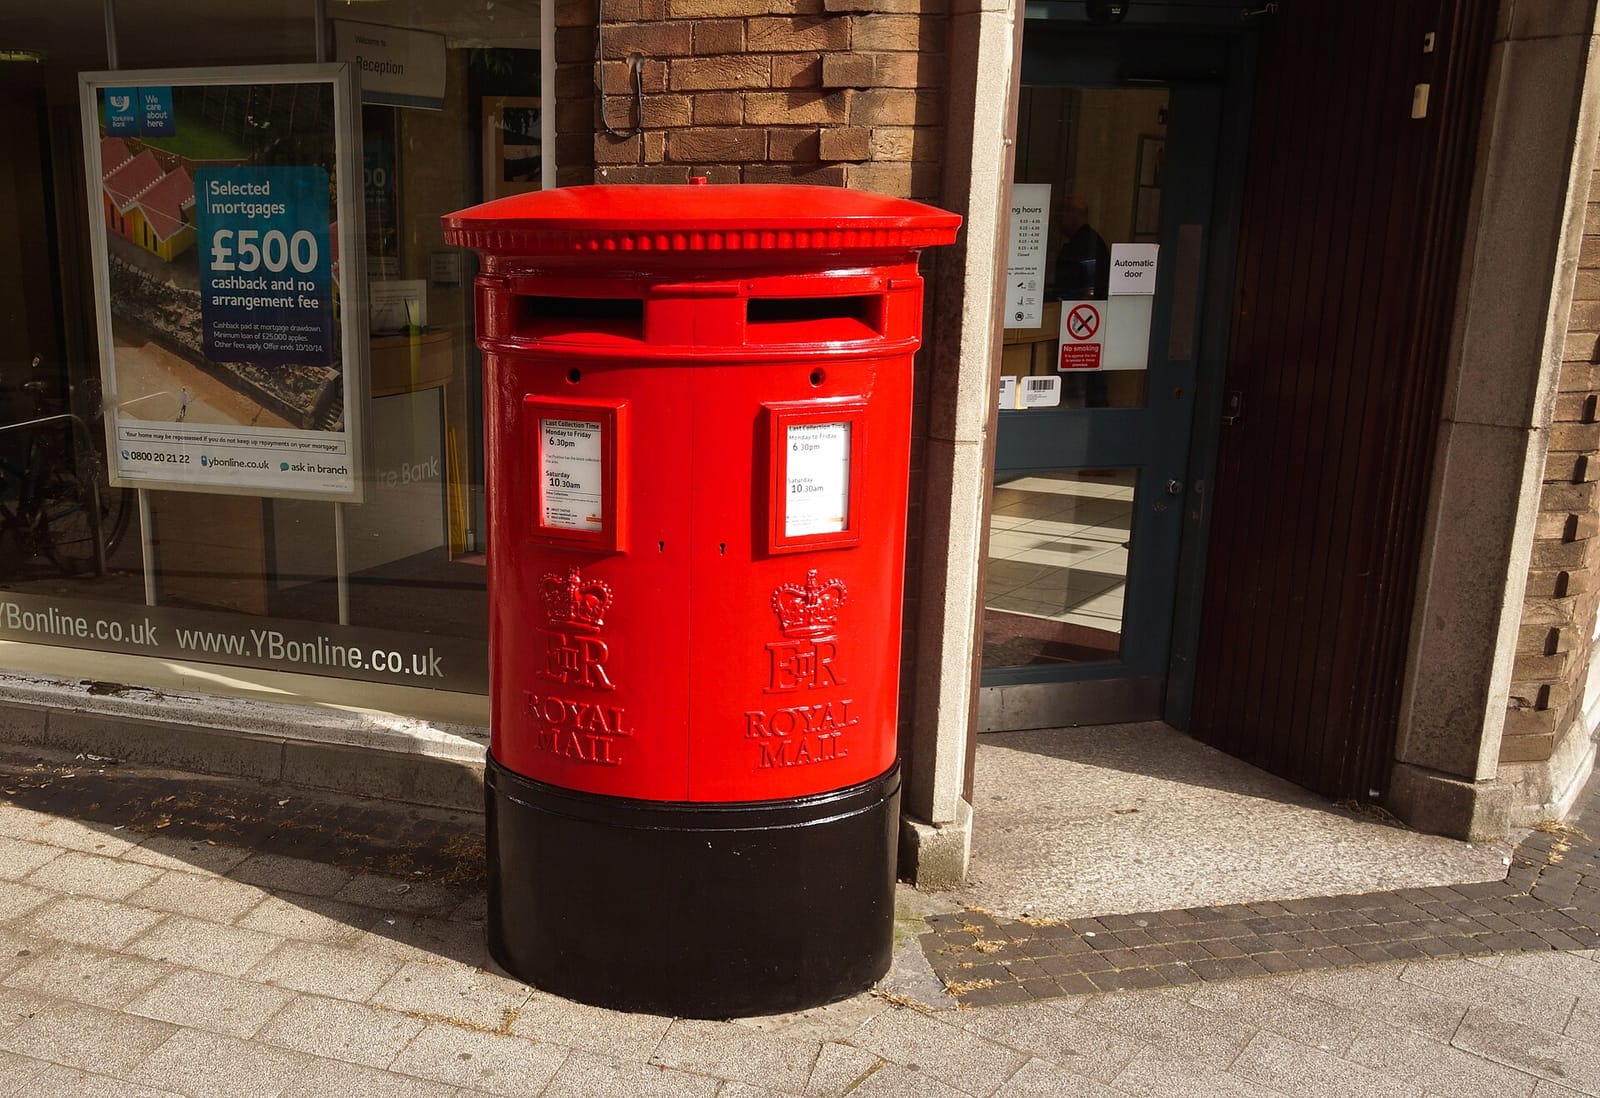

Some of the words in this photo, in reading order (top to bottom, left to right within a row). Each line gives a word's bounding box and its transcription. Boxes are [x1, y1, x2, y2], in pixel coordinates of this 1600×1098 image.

[145, 94, 159, 104] We
[146, 103, 162, 111] care
[147, 110, 169, 120] about
[147, 119, 165, 129] here
[210, 180, 271, 196] Selected
[212, 201, 286, 219] mortgages
[210, 229, 319, 273] £500
[1114, 259, 1155, 268] Automatic
[1124, 270, 1144, 279] door
[211, 276, 268, 290] cashback
[270, 277, 294, 291] and
[297, 281, 316, 291] no
[212, 295, 295, 311] arrangement
[297, 295, 320, 309] fee
[212, 321, 239, 330] Cashback
[240, 323, 253, 332] paid
[261, 324, 289, 333] mortgage
[213, 331, 240, 340] Minimum
[241, 332, 254, 340] loan
[255, 332, 261, 340] of
[214, 341, 232, 349] Other
[233, 342, 246, 350] fees
[262, 343, 279, 351] Offer
[1073, 344, 1100, 354] smoking
[558, 421, 586, 429] Collection
[545, 429, 566, 438] Monday
[574, 431, 592, 440] Friday
[153, 433, 165, 441] may
[237, 438, 250, 446] keep
[259, 440, 289, 448] repayments
[298, 442, 310, 450] your
[311, 443, 339, 451] mortgage
[549, 436, 577, 448] 6.30pm
[131, 451, 152, 462] 0800
[154, 453, 165, 462] 20
[167, 454, 178, 463] 21
[179, 455, 191, 464] 22
[208, 457, 270, 470] ybonline.co.uk
[291, 462, 306, 473] ask
[306, 463, 316, 473] in
[317, 464, 348, 475] branch
[401, 455, 440, 486] Bank
[545, 470, 571, 479] Saturday
[549, 477, 582, 489] 10.30am
[175, 628, 446, 678] www.YBonline.co.uk
[523, 690, 635, 736] ROYAL
[744, 699, 860, 739] ROYAL
[536, 727, 622, 766] MAIL
[756, 731, 849, 770] MAIL
